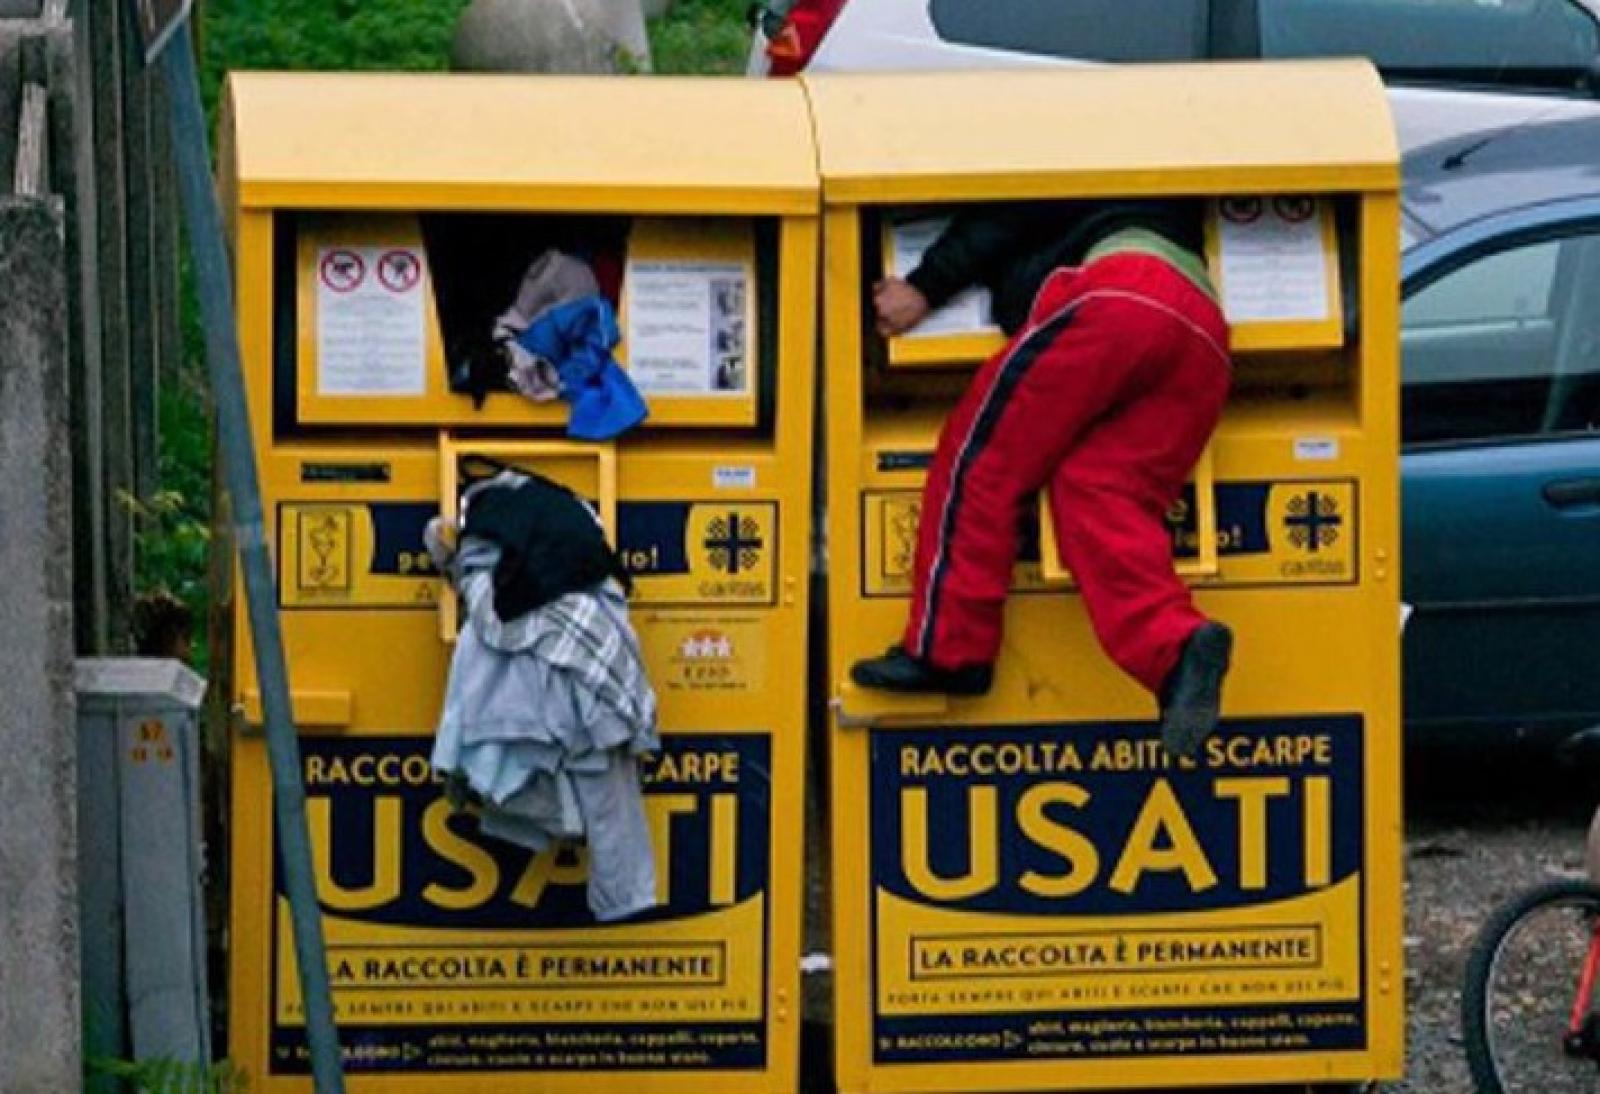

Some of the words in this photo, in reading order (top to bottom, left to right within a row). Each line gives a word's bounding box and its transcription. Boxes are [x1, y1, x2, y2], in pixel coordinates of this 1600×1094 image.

[900, 743, 1083, 776] RACCOLTA
[1205, 736, 1333, 768] SCARPE
[901, 774, 1331, 900] USATI
[364, 957, 508, 979] RACCOLTA
[541, 956, 713, 978] PERMANENTE
[921, 950, 953, 969] LA
[962, 945, 1107, 968] RACCOLTA
[1137, 938, 1311, 962] PERMANENTE
